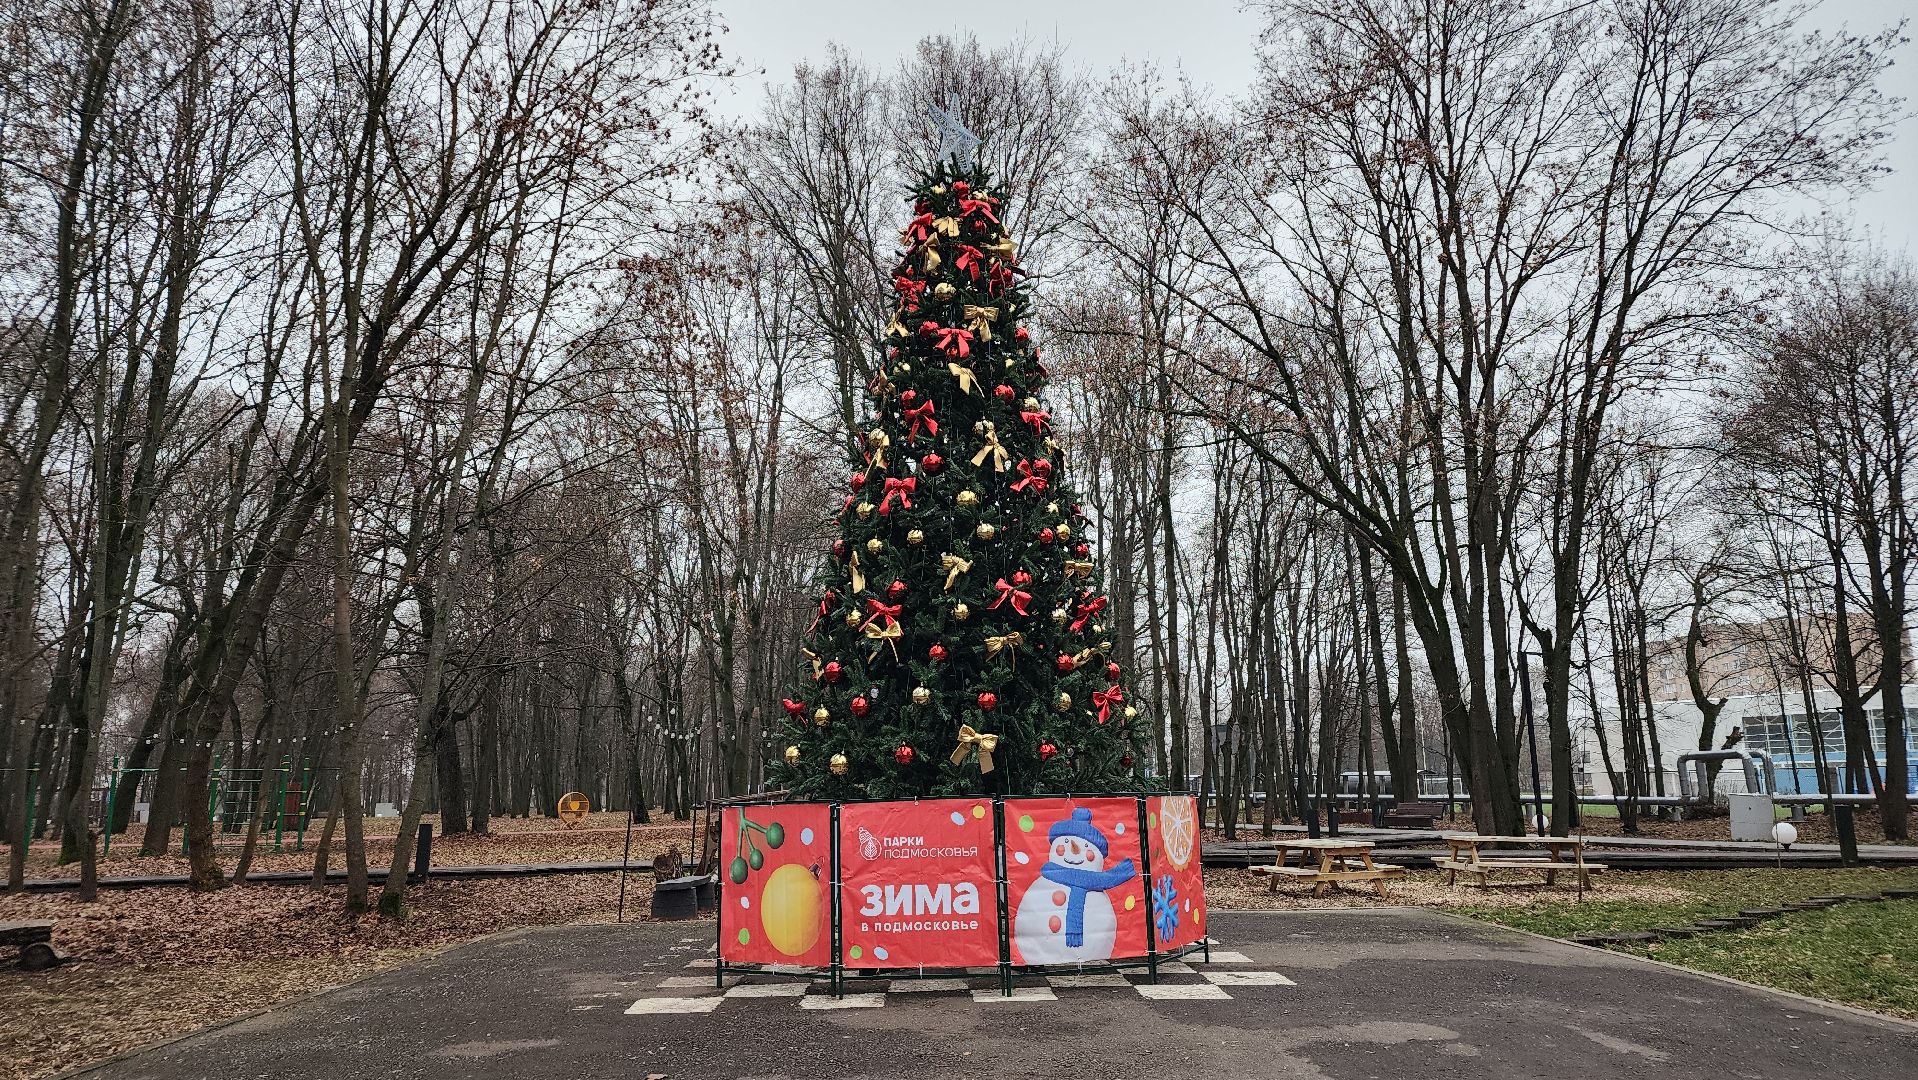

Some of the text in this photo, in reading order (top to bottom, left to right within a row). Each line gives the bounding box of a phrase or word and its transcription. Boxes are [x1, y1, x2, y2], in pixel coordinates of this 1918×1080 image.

[884, 836, 924, 847] ПАРКИ
[884, 846, 978, 859] ПОДМОСКОВЬЯ
[861, 920, 979, 933] в подмосковье
